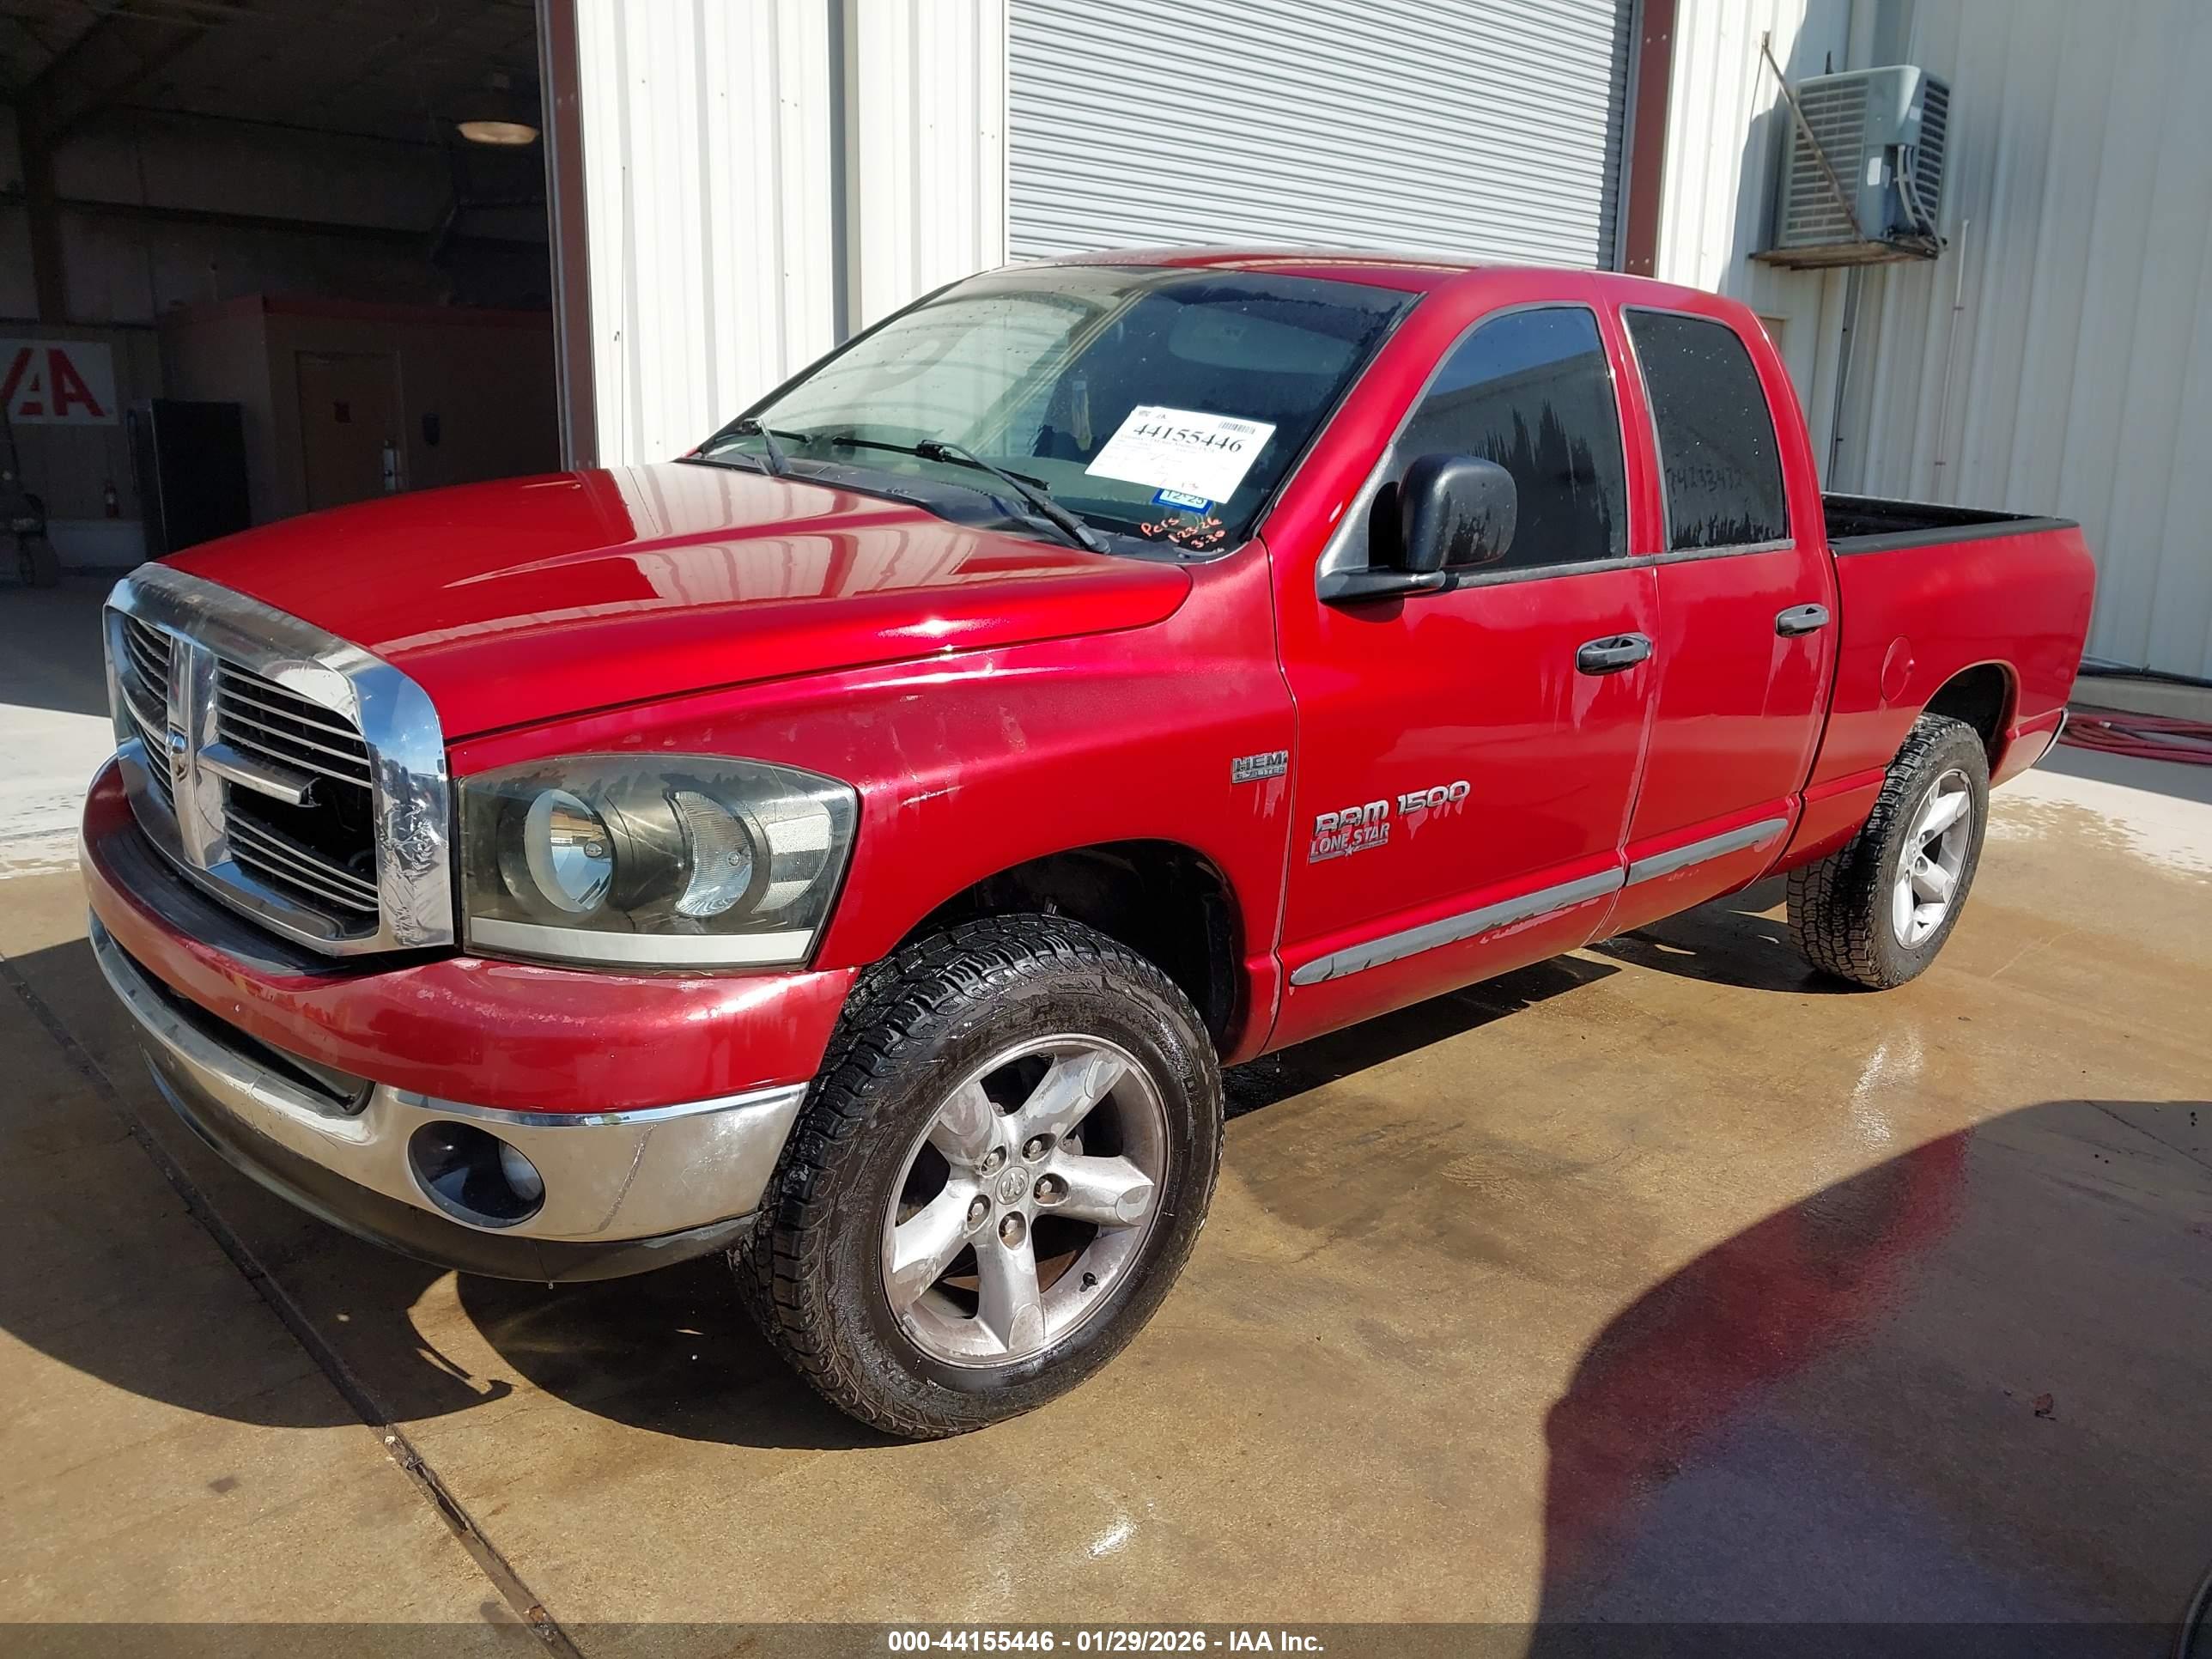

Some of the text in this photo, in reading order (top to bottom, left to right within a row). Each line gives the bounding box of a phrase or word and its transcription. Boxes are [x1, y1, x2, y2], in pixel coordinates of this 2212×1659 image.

[1133, 423, 1244, 453] 44155446
[1315, 780, 1470, 836] RAM 1500
[1310, 821, 1390, 856] LONE STAR
